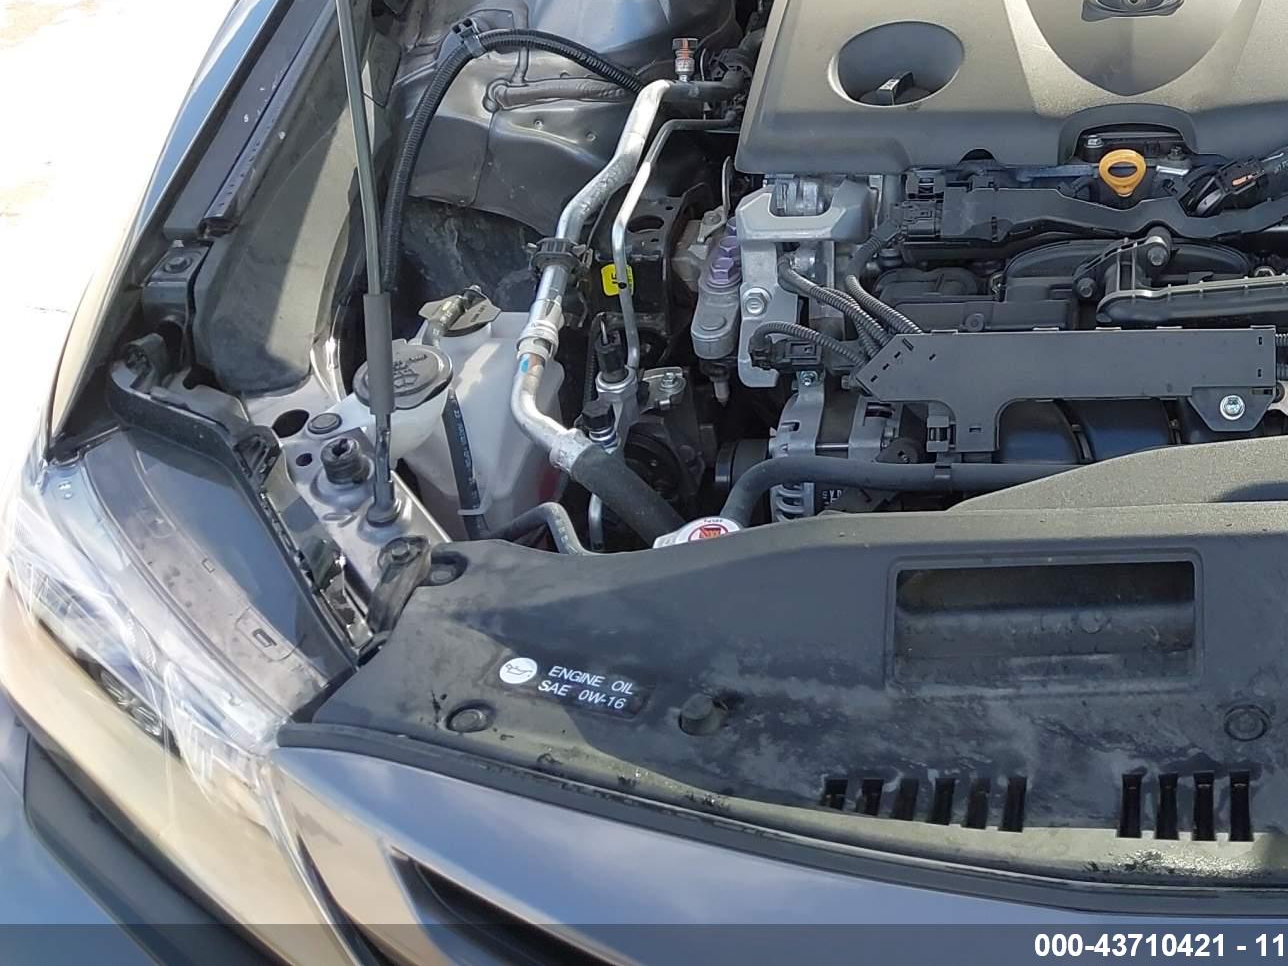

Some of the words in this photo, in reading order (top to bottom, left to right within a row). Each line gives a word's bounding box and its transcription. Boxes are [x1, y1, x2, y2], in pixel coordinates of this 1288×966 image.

[538, 679, 572, 697] SAE
[578, 689, 627, 709] 0W-16
[548, 665, 606, 688] ENGINE
[611, 680, 634, 695] OIL
